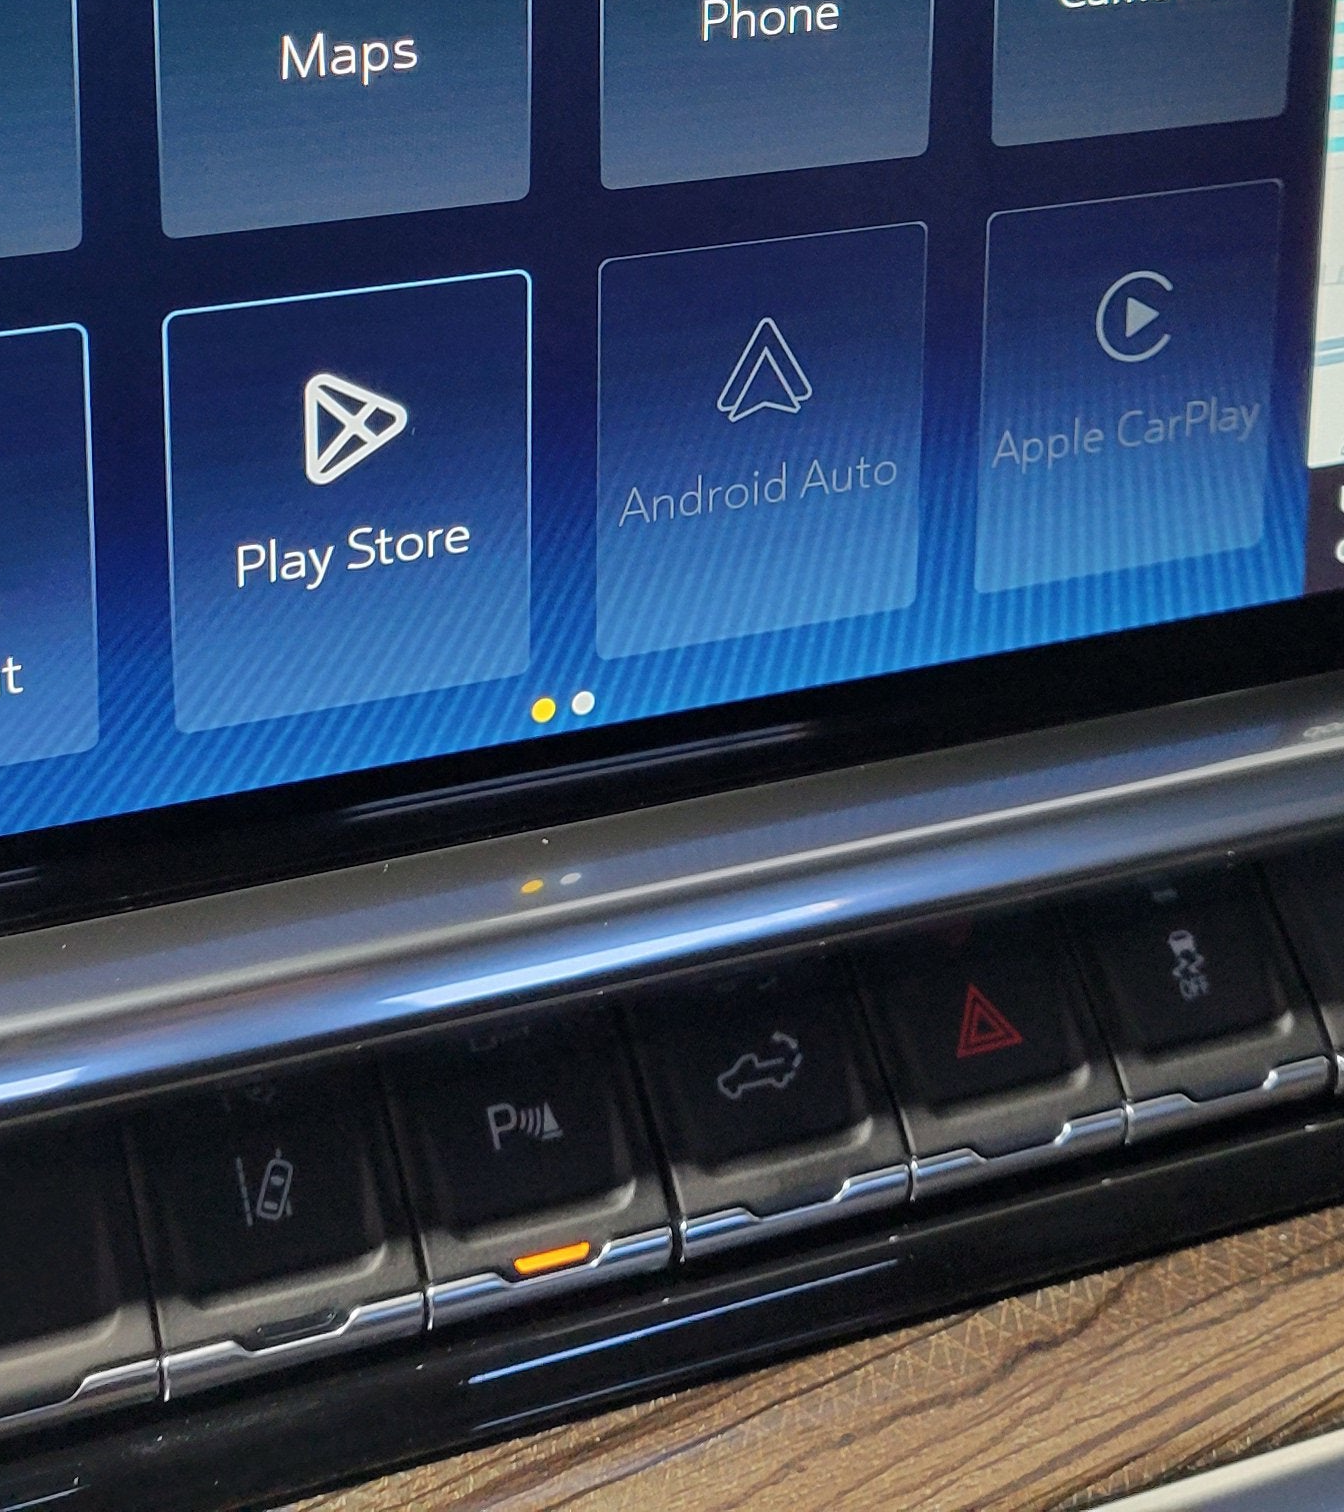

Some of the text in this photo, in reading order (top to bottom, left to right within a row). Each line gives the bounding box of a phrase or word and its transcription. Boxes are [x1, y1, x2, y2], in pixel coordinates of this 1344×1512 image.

[281, 32, 419, 86] Maps
[992, 397, 1261, 473] Apple CarPlay
[618, 454, 899, 528] Android Auto
[236, 524, 472, 591] Play Store
